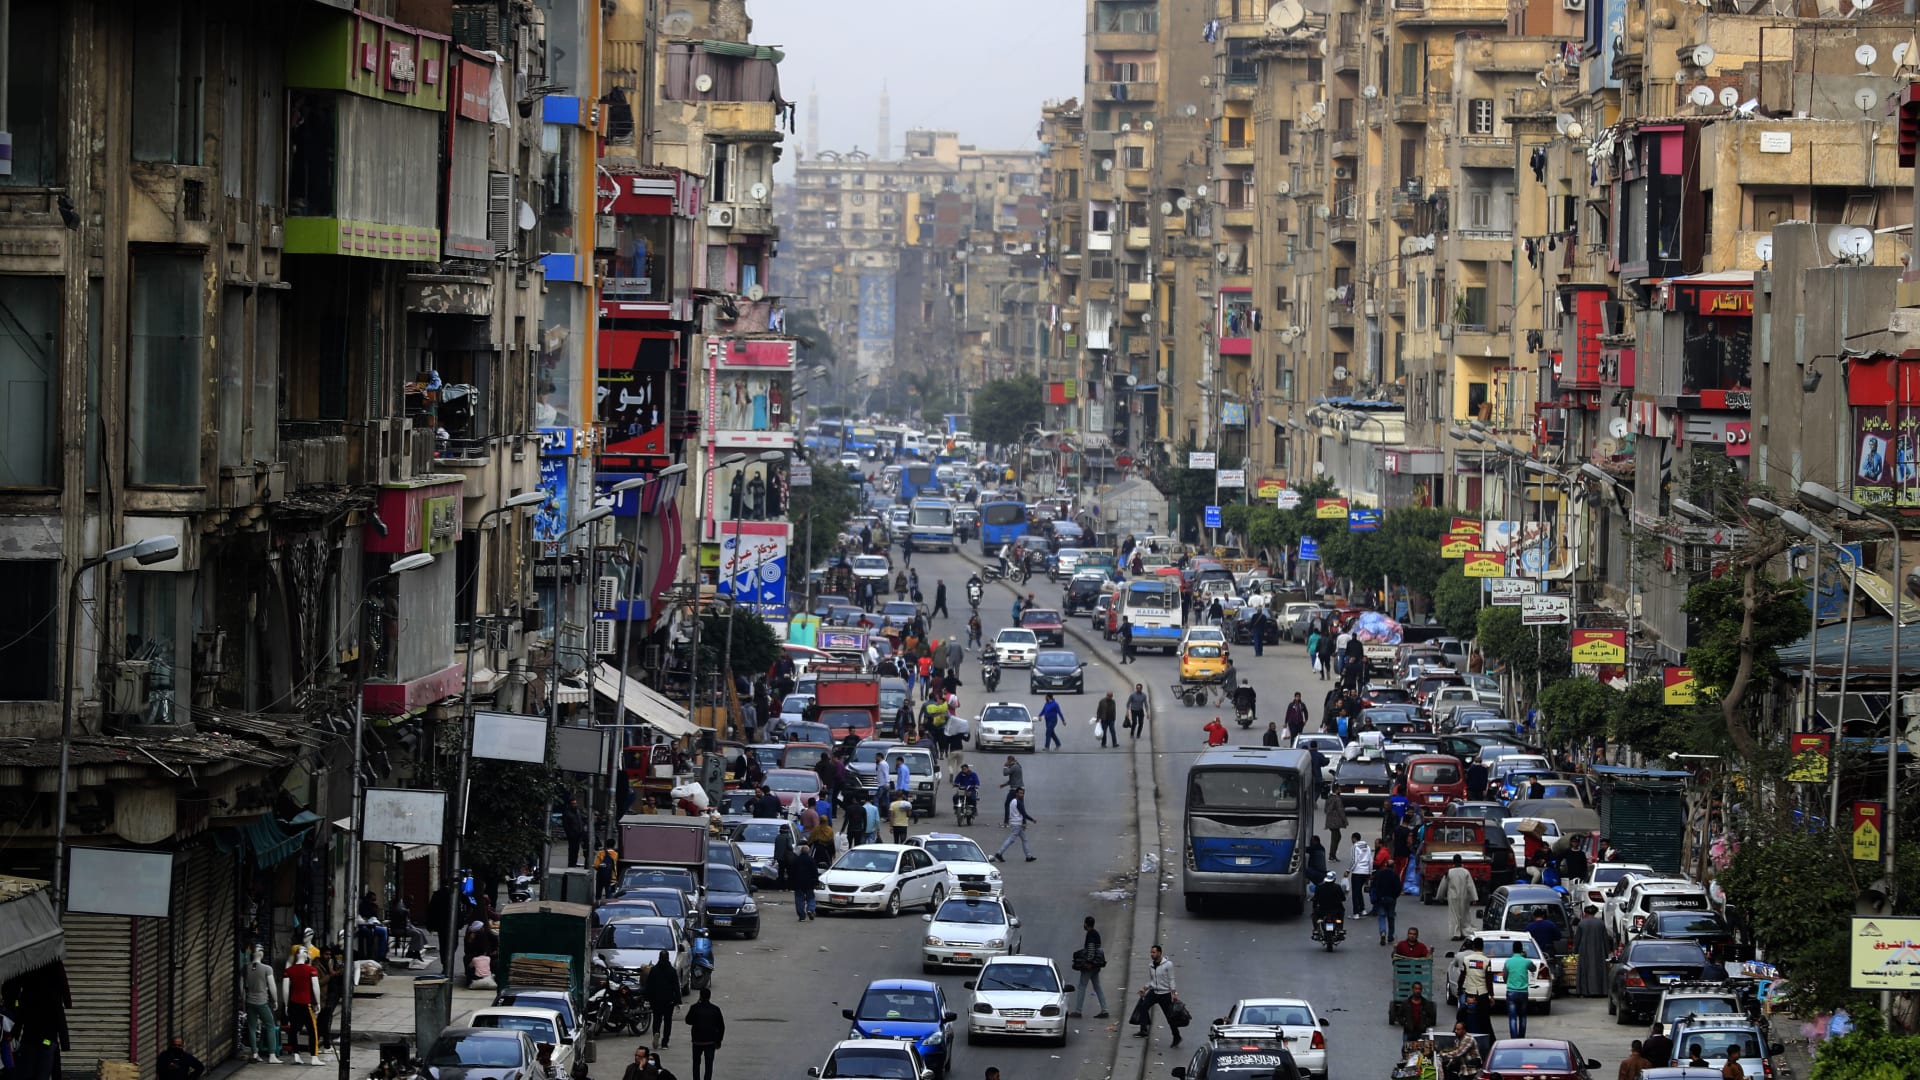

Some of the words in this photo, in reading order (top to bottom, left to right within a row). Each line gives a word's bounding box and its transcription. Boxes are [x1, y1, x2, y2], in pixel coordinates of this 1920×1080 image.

[615, 375, 652, 415] أبو
[1524, 603, 1544, 612] راغب
[1873, 940, 1905, 950] الشروق
